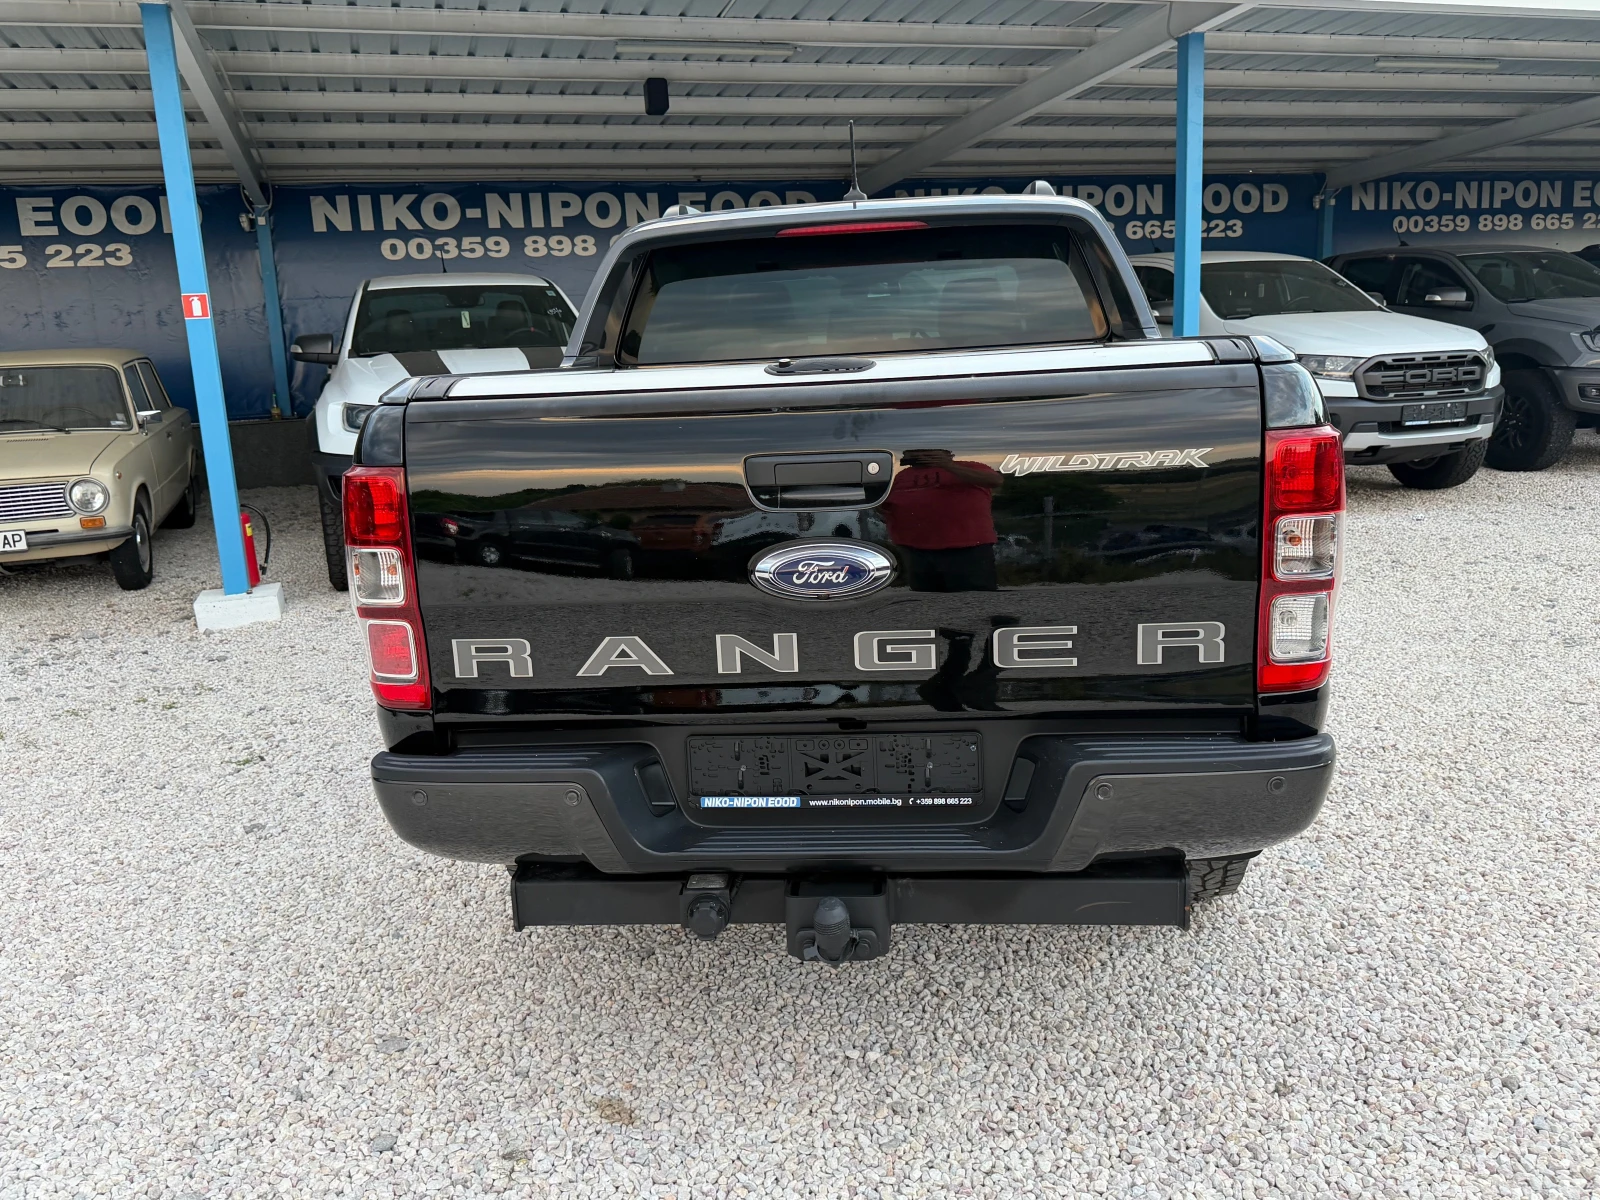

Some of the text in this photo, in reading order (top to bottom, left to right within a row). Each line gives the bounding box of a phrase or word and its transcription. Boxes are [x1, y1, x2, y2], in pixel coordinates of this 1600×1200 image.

[1202, 183, 1289, 214] OOD
[1351, 180, 1562, 211] NIKO-NIPON
[309, 192, 660, 233] NIKO-NIPON
[1392, 212, 1600, 234] 00359 898 665 2
[1125, 220, 1175, 240] 665
[44, 242, 133, 268] 223
[380, 236, 510, 261] 00359
[524, 235, 597, 257] 898
[999, 447, 1214, 477] WILDTRAK
[2, 533, 23, 549] AP
[792, 560, 850, 585] Ford
[451, 621, 1226, 678] RANGER
[704, 797, 767, 808] NIKO-NIPON
[767, 797, 797, 807] EOOD
[808, 797, 902, 807] www.nikonipon.mobile.bg
